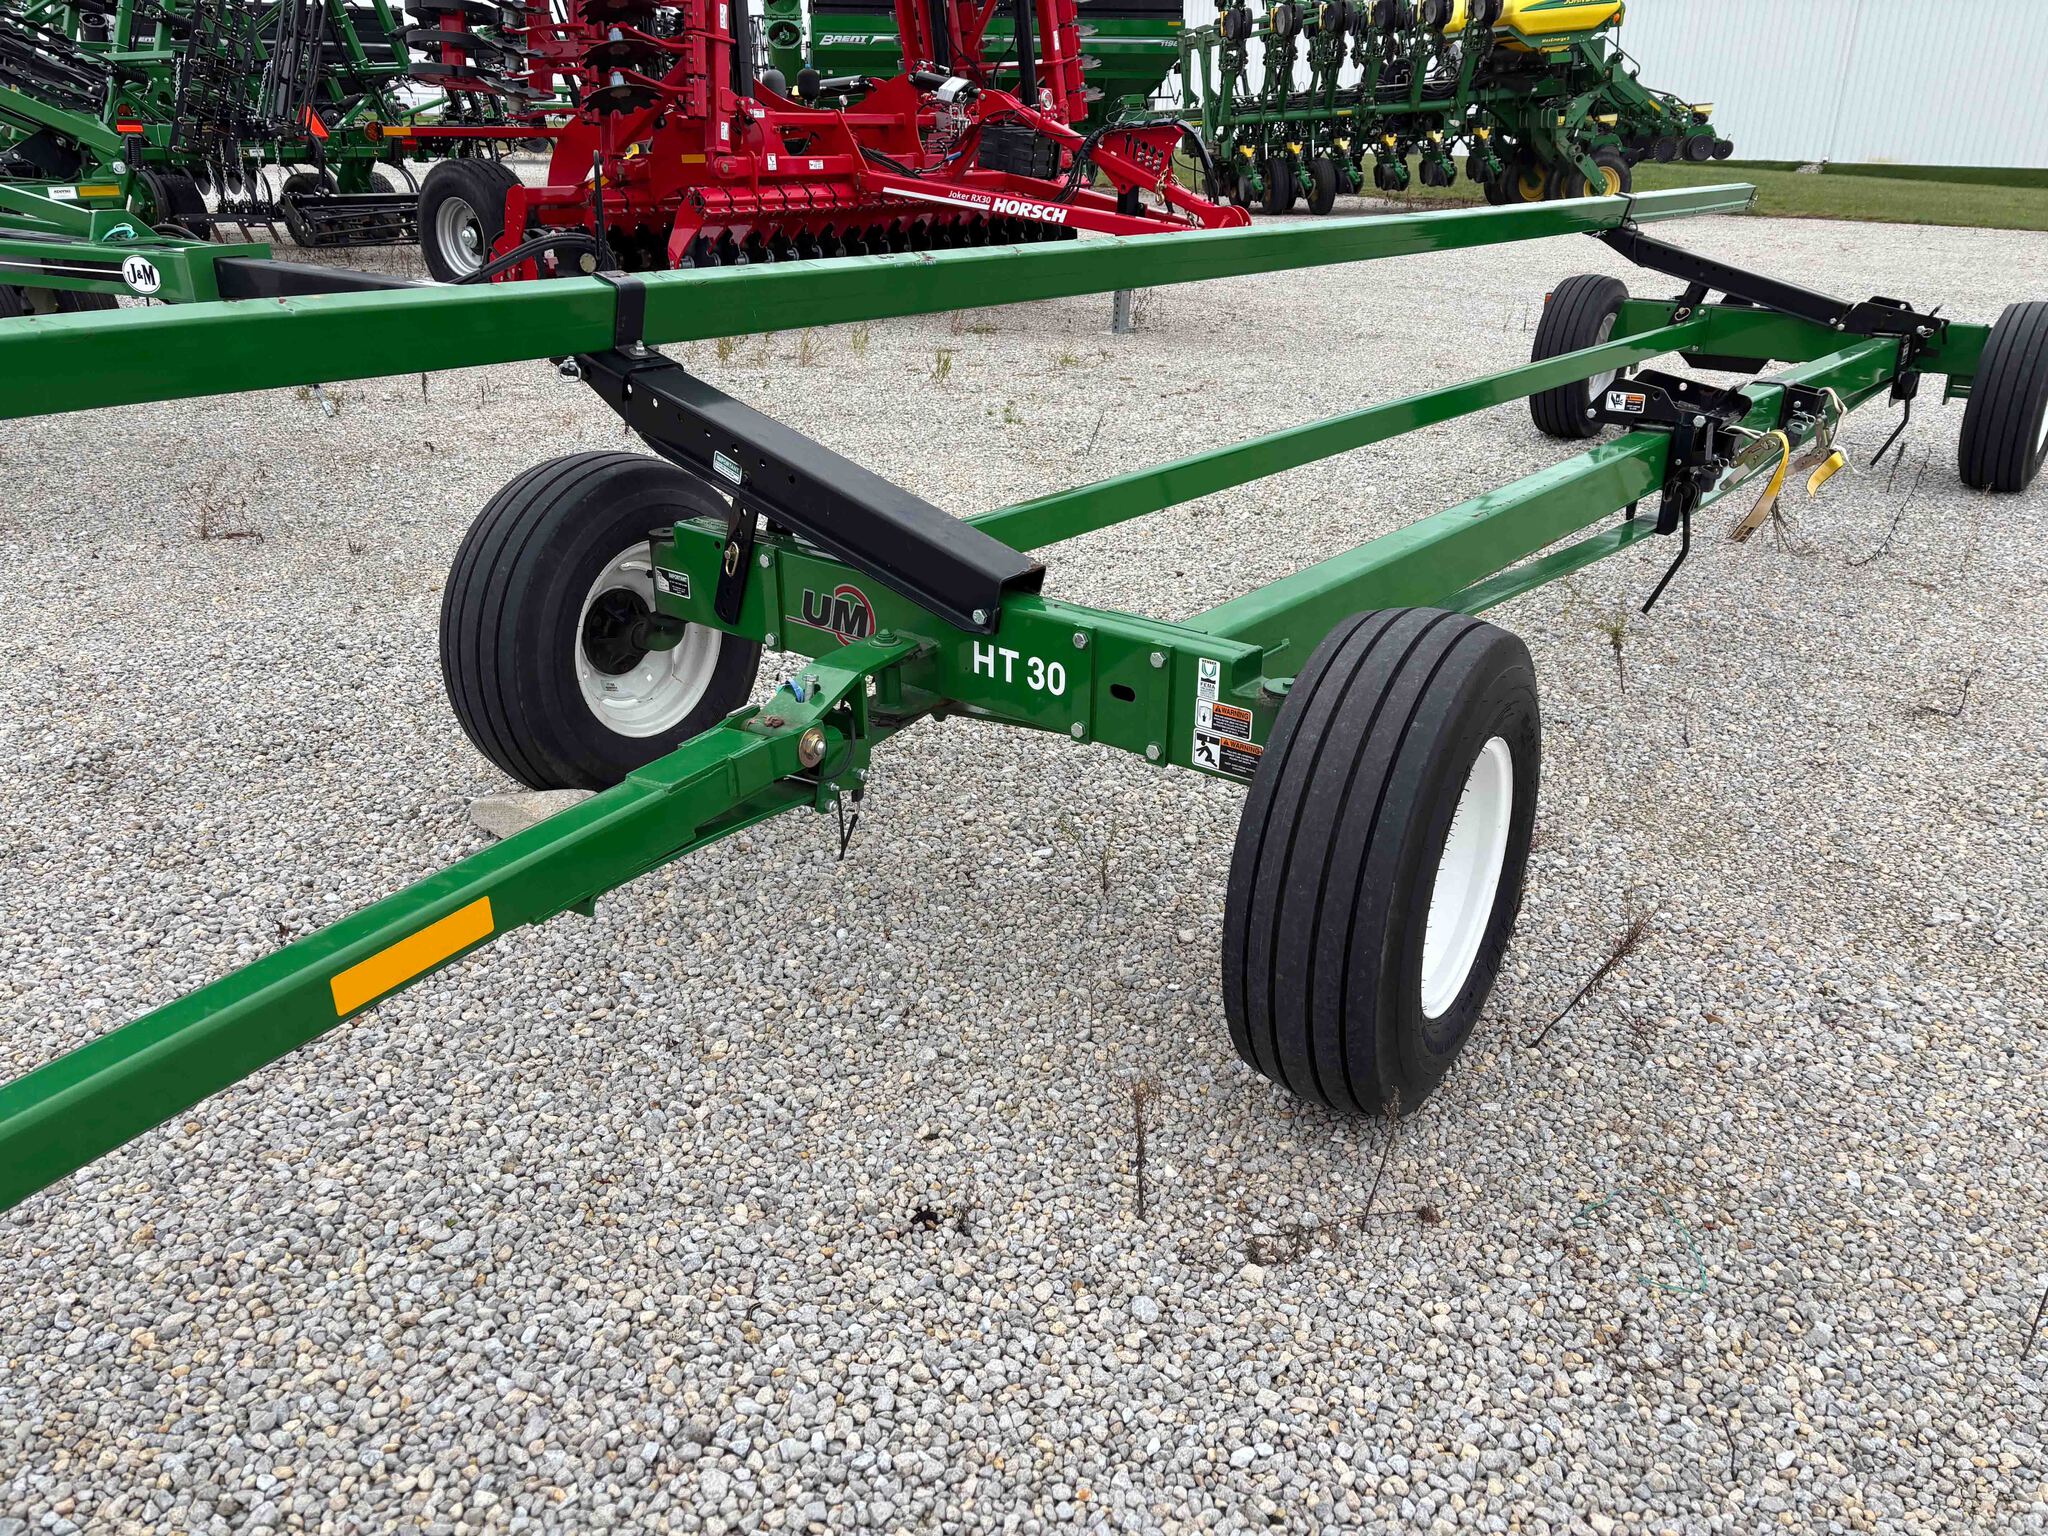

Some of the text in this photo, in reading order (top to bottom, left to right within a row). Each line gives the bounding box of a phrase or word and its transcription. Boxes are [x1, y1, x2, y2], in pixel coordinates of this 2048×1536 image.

[948, 190, 1068, 224] Joker RX30 HORSCH
[127, 263, 156, 286] J&M
[801, 588, 869, 638] UM
[973, 640, 1066, 696] HT 30
[1221, 707, 1249, 720] WARNING
[1230, 740, 1261, 755] WARNING
